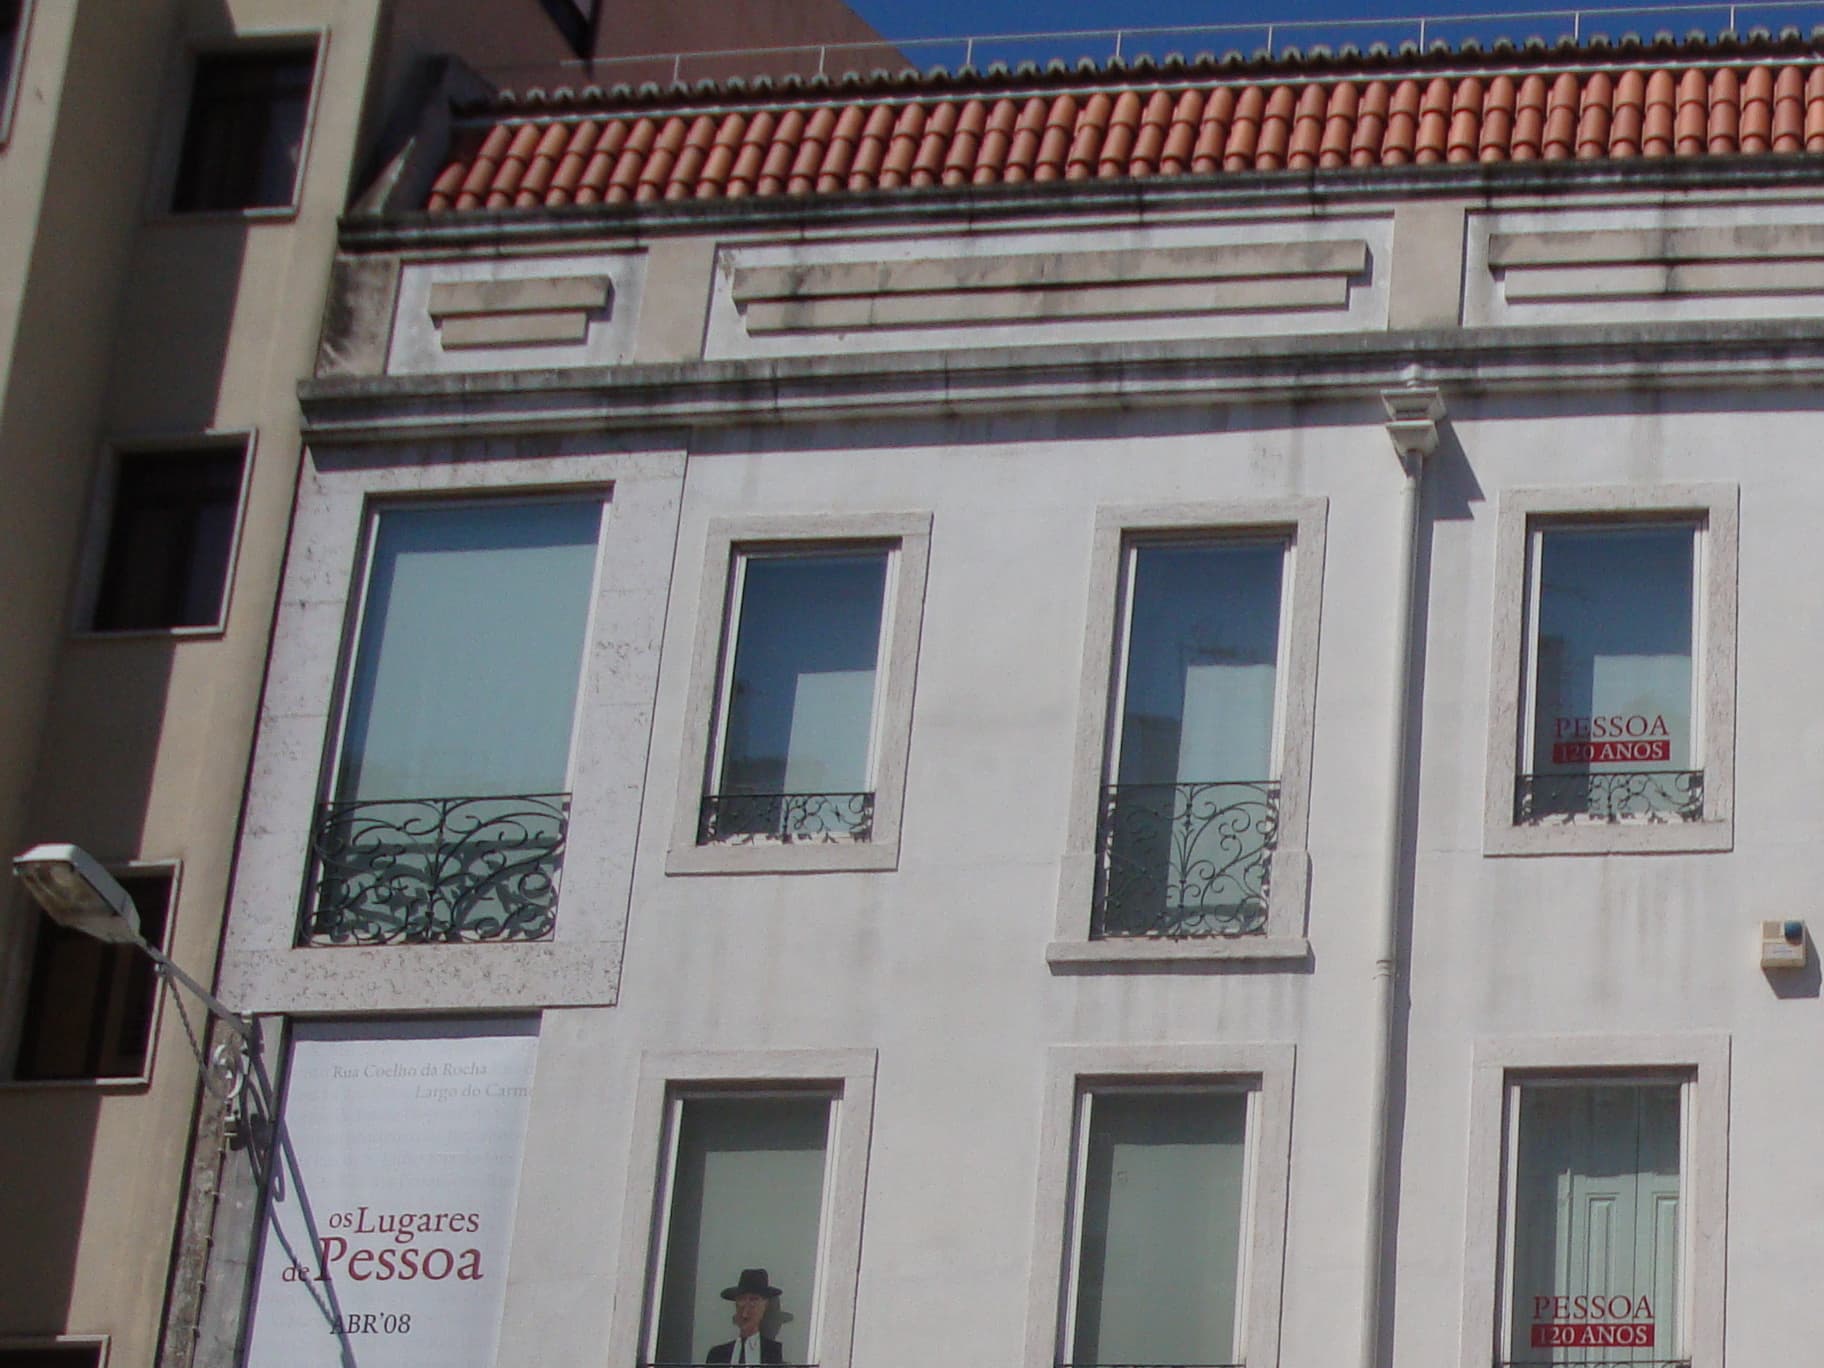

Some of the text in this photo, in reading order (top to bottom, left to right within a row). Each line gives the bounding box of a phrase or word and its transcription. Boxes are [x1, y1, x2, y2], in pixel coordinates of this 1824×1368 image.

[1554, 714, 1670, 738] PESSOA
[1560, 741, 1663, 760] 120 ANOS
[333, 1064, 359, 1079] Rua
[364, 1063, 418, 1079] Coelho
[420, 1064, 439, 1078] da
[442, 1062, 488, 1077] Rocha
[415, 1084, 458, 1103] Largo
[462, 1082, 481, 1098] do
[329, 1206, 480, 1244] os Lugares
[282, 1235, 484, 1283] de Pessoa
[1532, 1294, 1655, 1320] PESSOA
[1540, 1325, 1648, 1345] 120 ANOS
